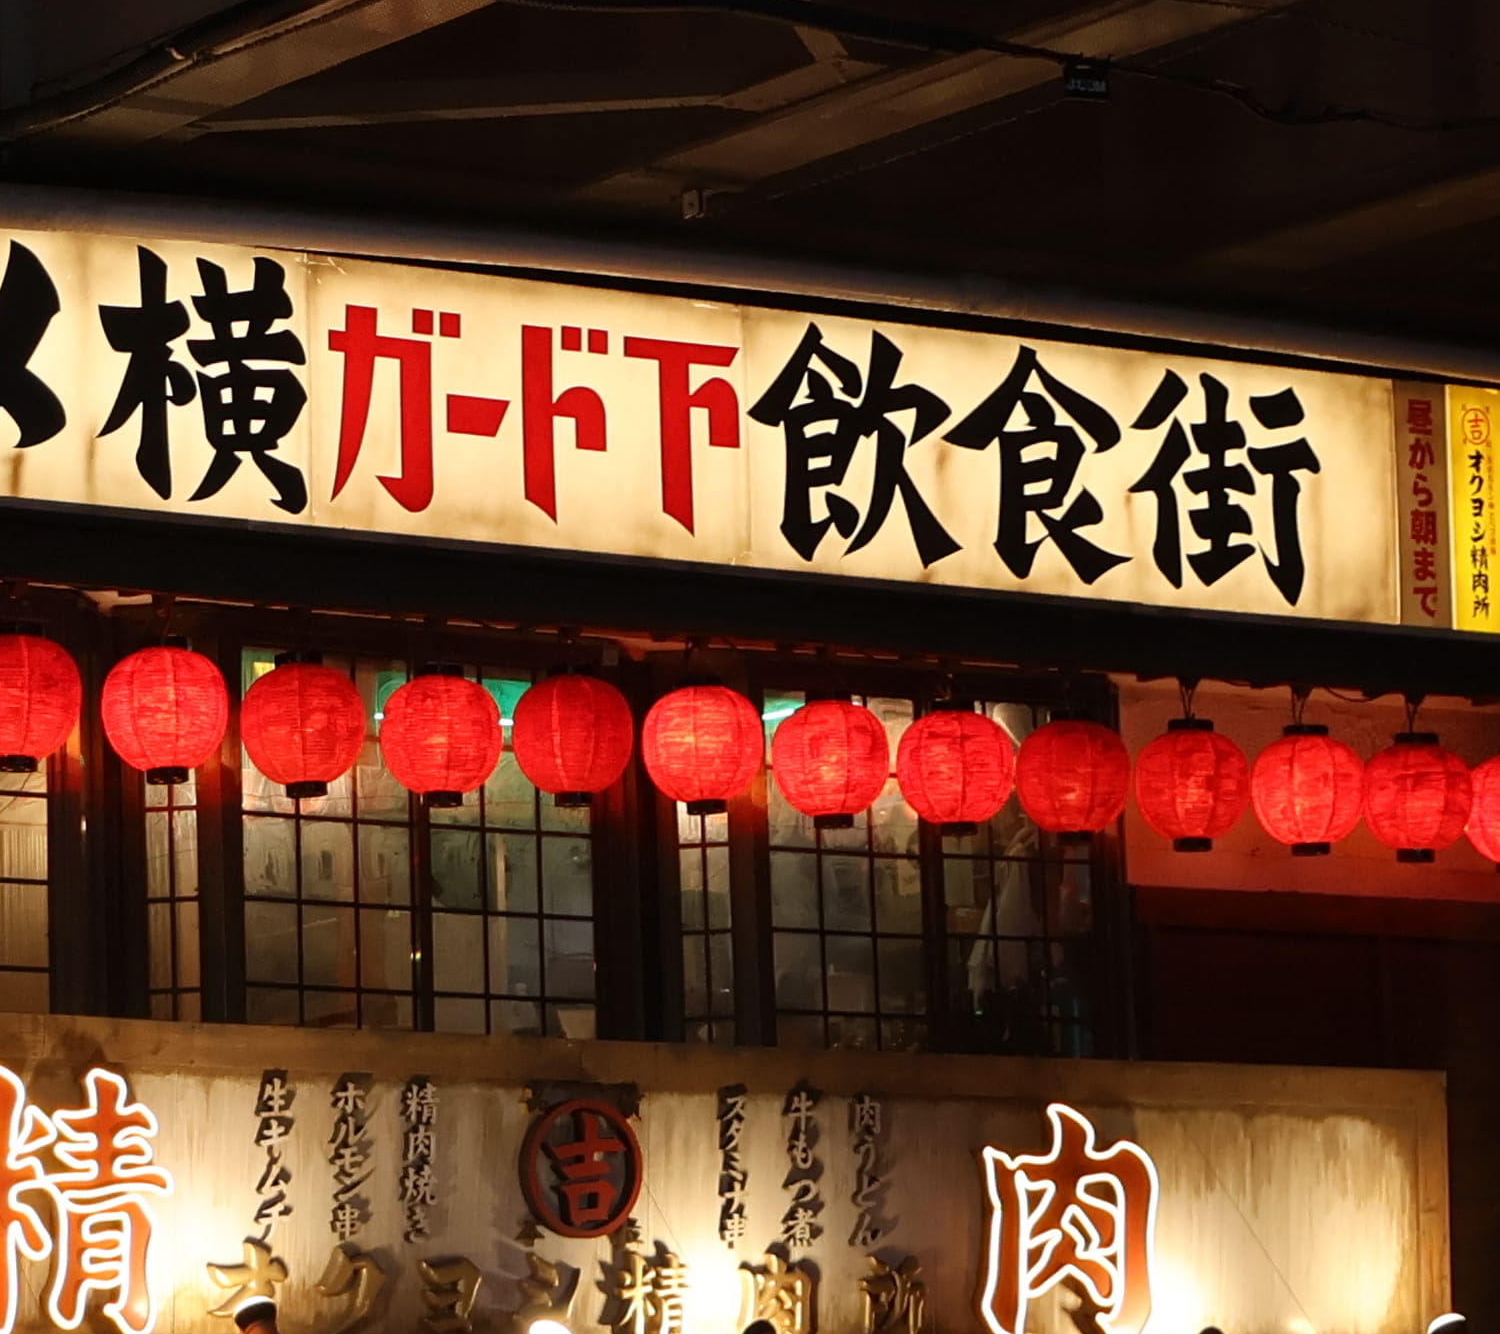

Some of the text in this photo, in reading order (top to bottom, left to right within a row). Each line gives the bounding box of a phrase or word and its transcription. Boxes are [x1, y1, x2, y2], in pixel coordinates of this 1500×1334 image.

[1407, 398, 1438, 618] 昼から朝まで
[1467, 449, 1490, 619] オクヨシ精肉所
[256, 1076, 294, 1239] 生キムチ
[330, 1081, 368, 1241] ホルモン串
[403, 1081, 440, 1244] 精肉焼き
[542, 1105, 634, 1233] 吉
[721, 1094, 749, 1249] スタミナ串
[783, 1090, 821, 1247] 牛もつ煮
[853, 1096, 883, 1248] 肉うどん
